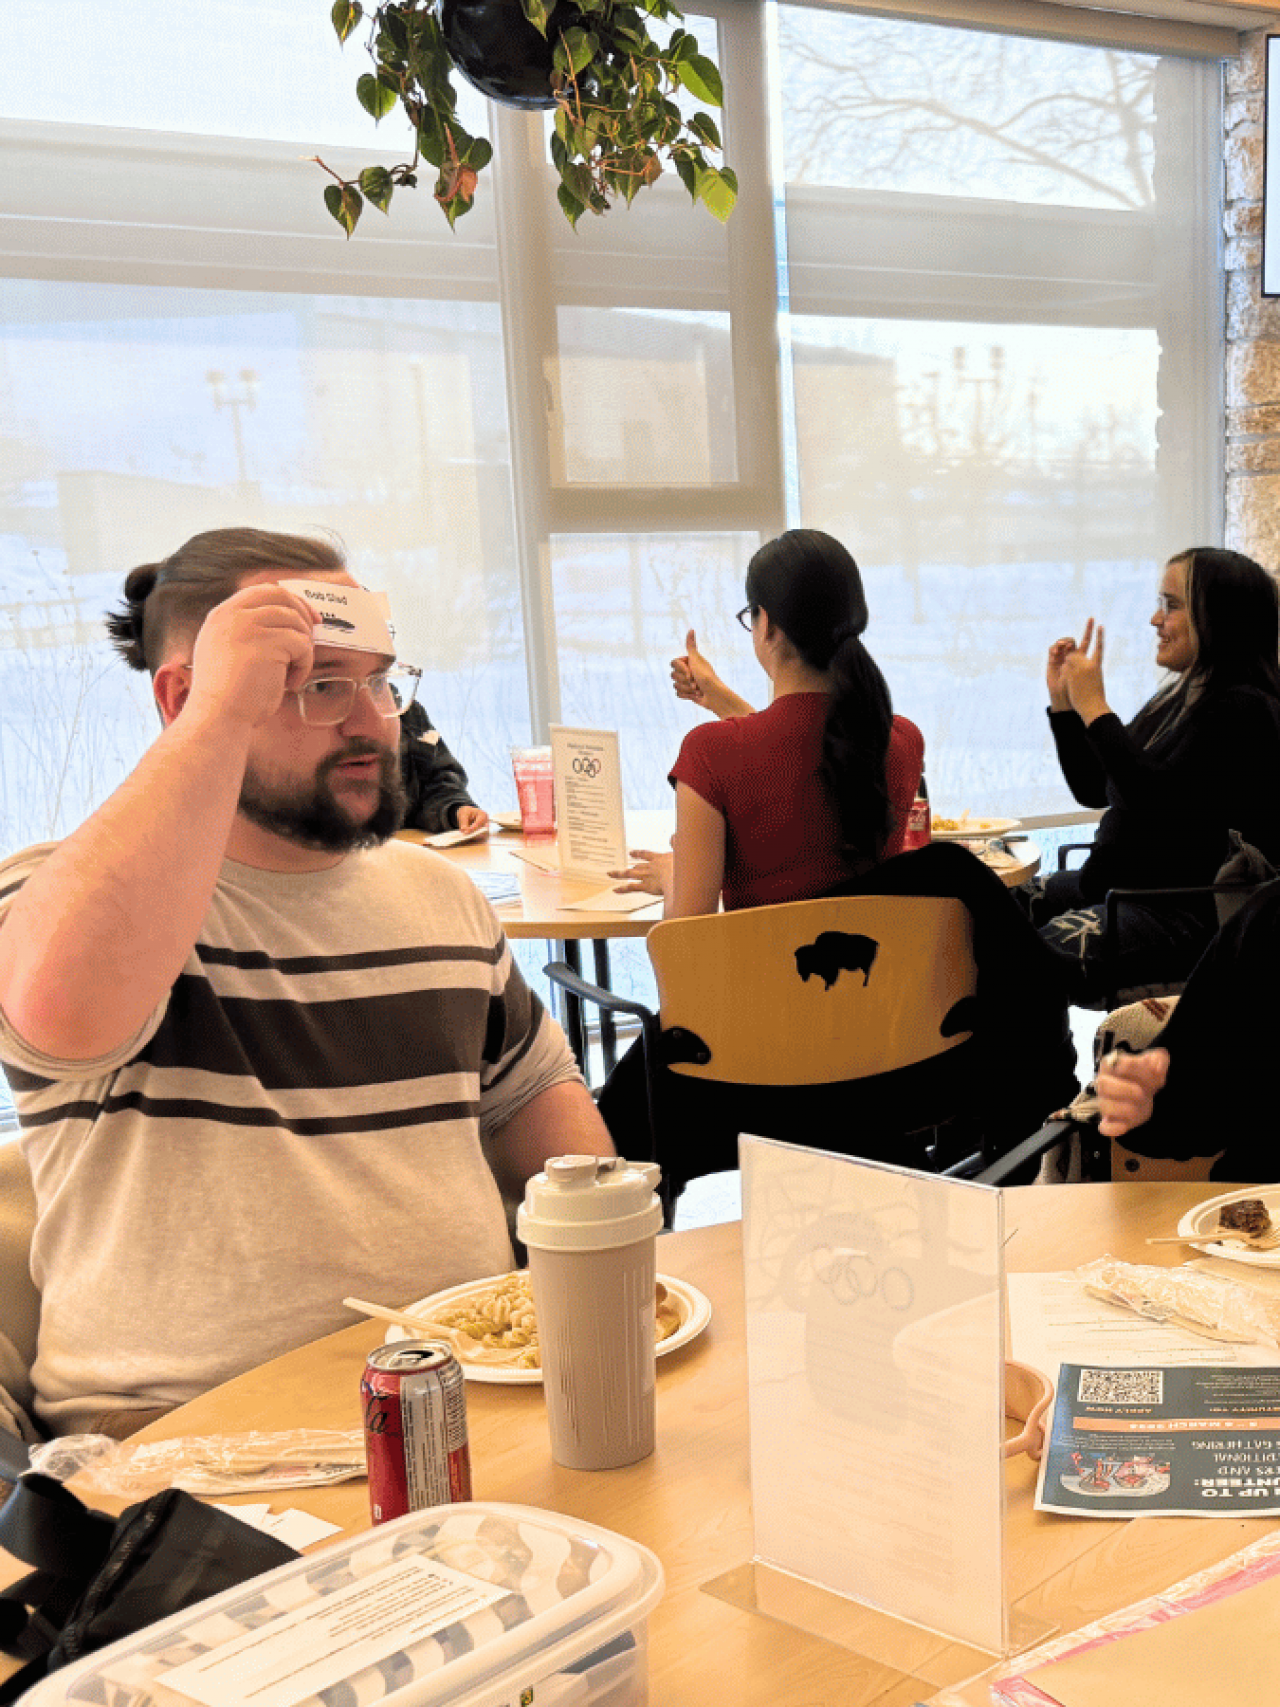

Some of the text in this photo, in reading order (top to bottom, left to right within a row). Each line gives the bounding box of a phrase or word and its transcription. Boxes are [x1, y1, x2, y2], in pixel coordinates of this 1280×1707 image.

[1169, 1421, 1221, 1429] MARCH
[1190, 1439, 1272, 1450] GATHERING
[1216, 1465, 1250, 1476] AND
[1201, 1488, 1233, 1498] TO
[1238, 1487, 1269, 1498] UP
